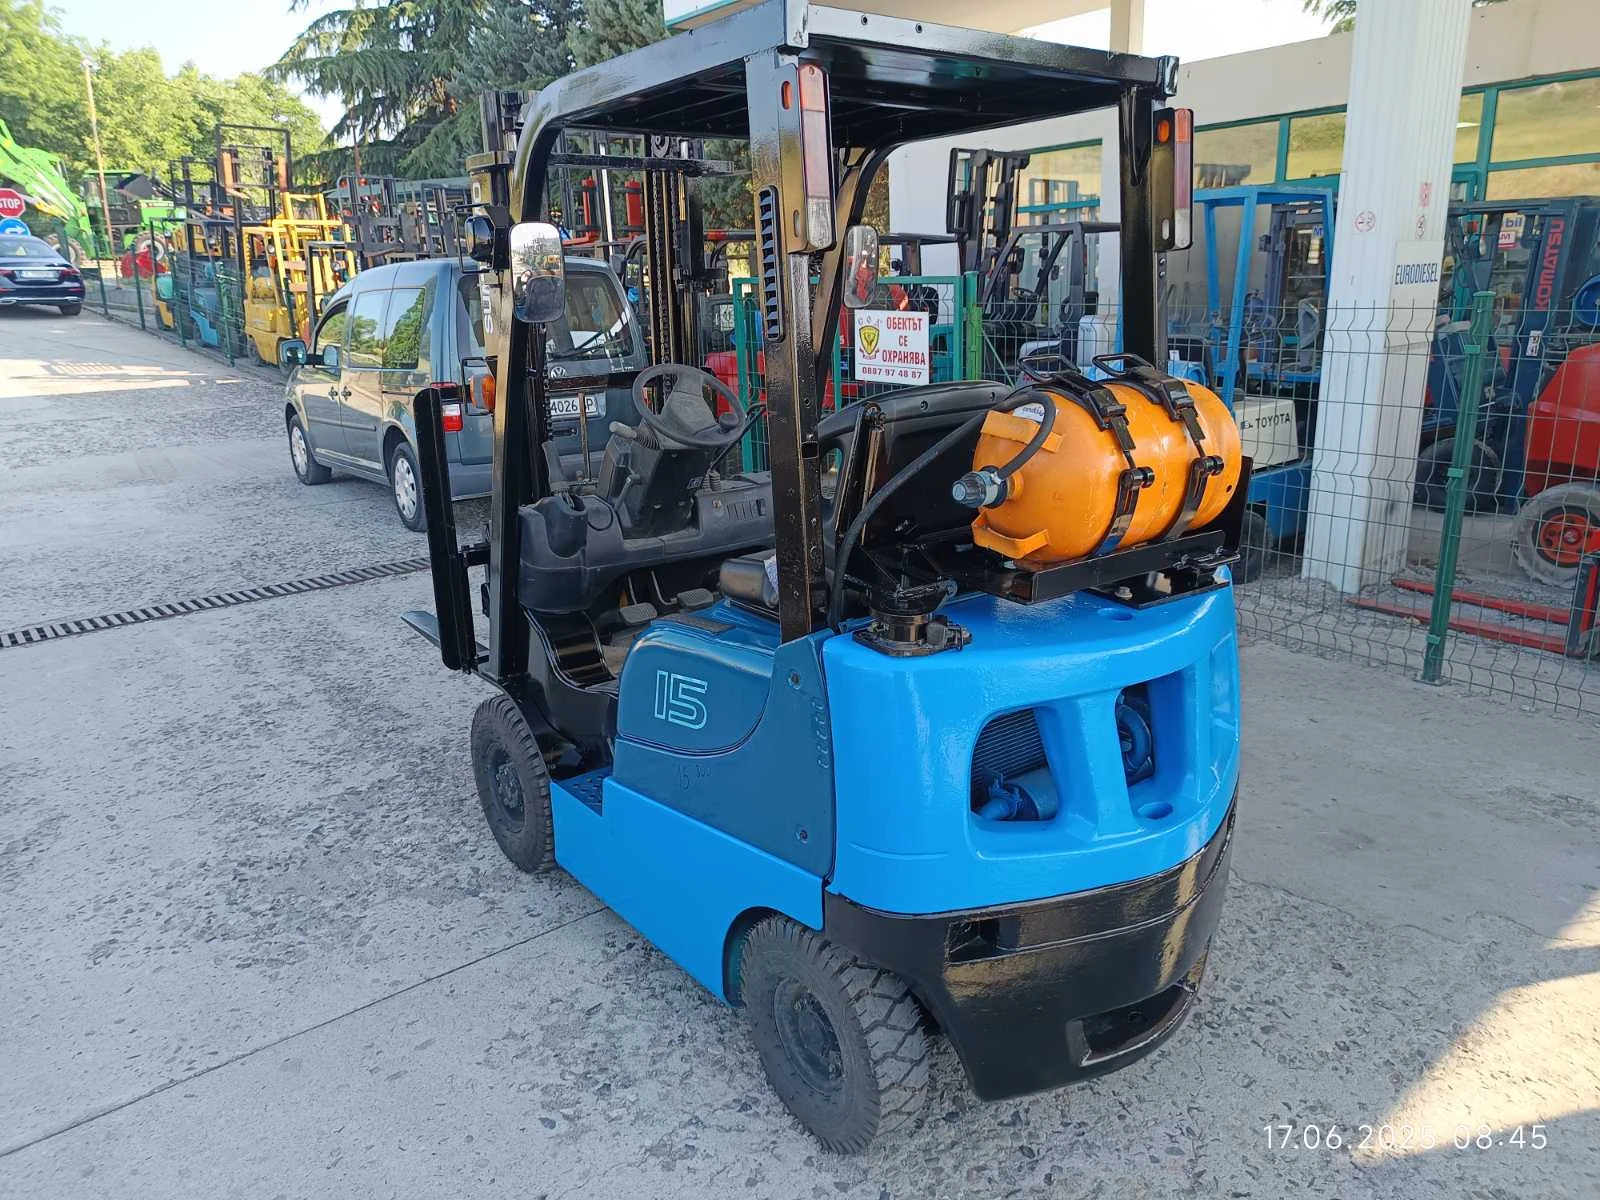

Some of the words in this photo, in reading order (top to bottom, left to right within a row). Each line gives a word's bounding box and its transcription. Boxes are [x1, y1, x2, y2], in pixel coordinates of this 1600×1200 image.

[1394, 263, 1438, 285] EURODIESEL
[1535, 219, 1565, 312] KOMATSU
[886, 316, 923, 331] ОБЕКТЪТ
[898, 335, 908, 347] СЕ
[882, 349, 926, 366] ОХРАНЯВА
[1255, 412, 1291, 429] TOYOTA
[654, 669, 708, 730] 15
